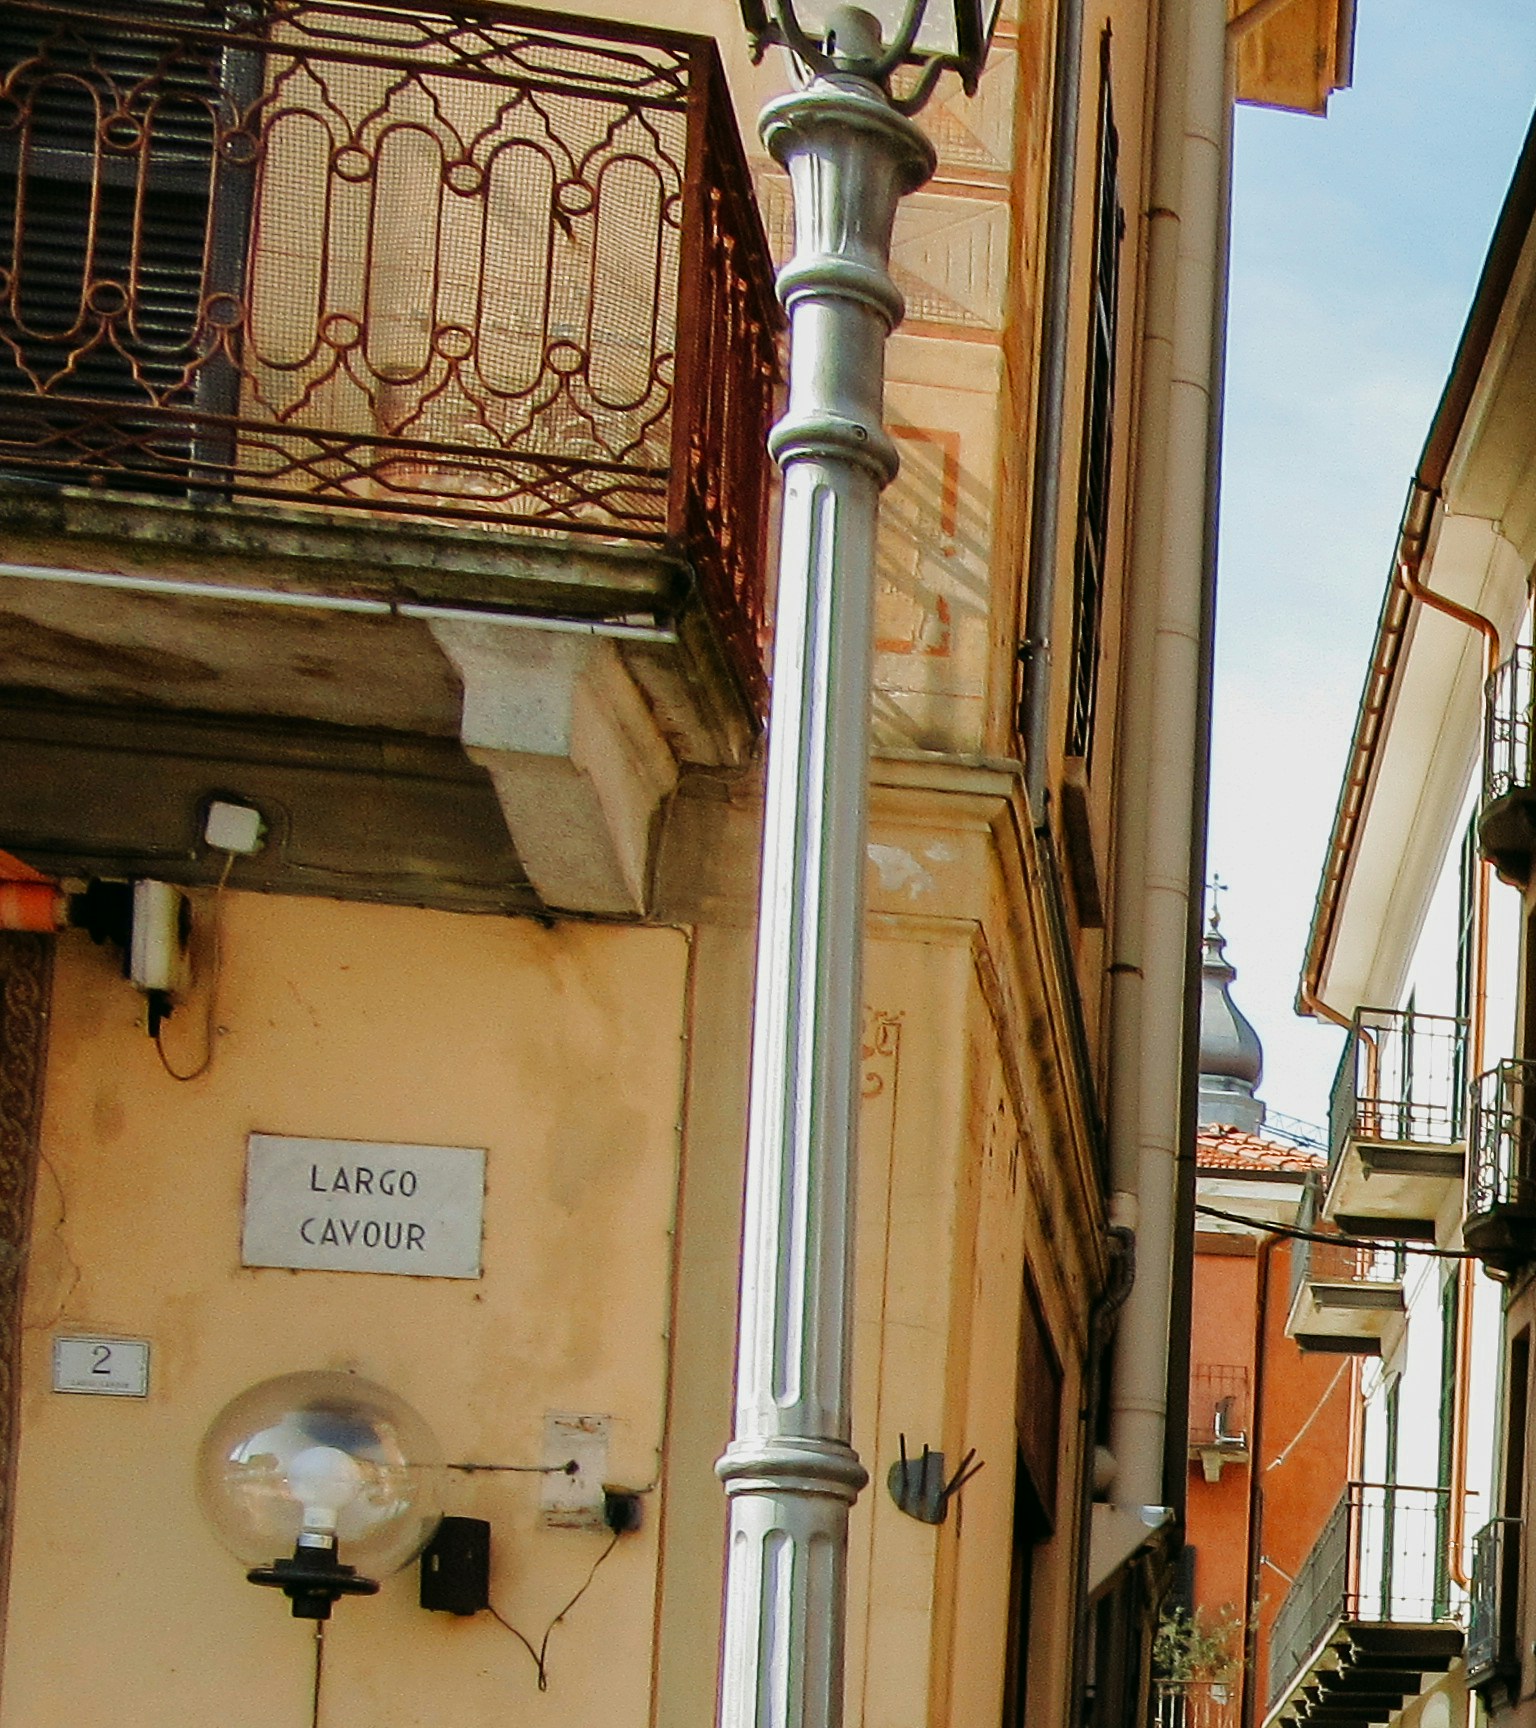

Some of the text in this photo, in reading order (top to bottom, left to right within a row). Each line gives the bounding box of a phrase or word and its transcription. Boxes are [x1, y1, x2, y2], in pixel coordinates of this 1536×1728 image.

[311, 1164, 417, 1198] LARGO
[300, 1217, 426, 1251] CAVOUR
[91, 1345, 111, 1374] 2
